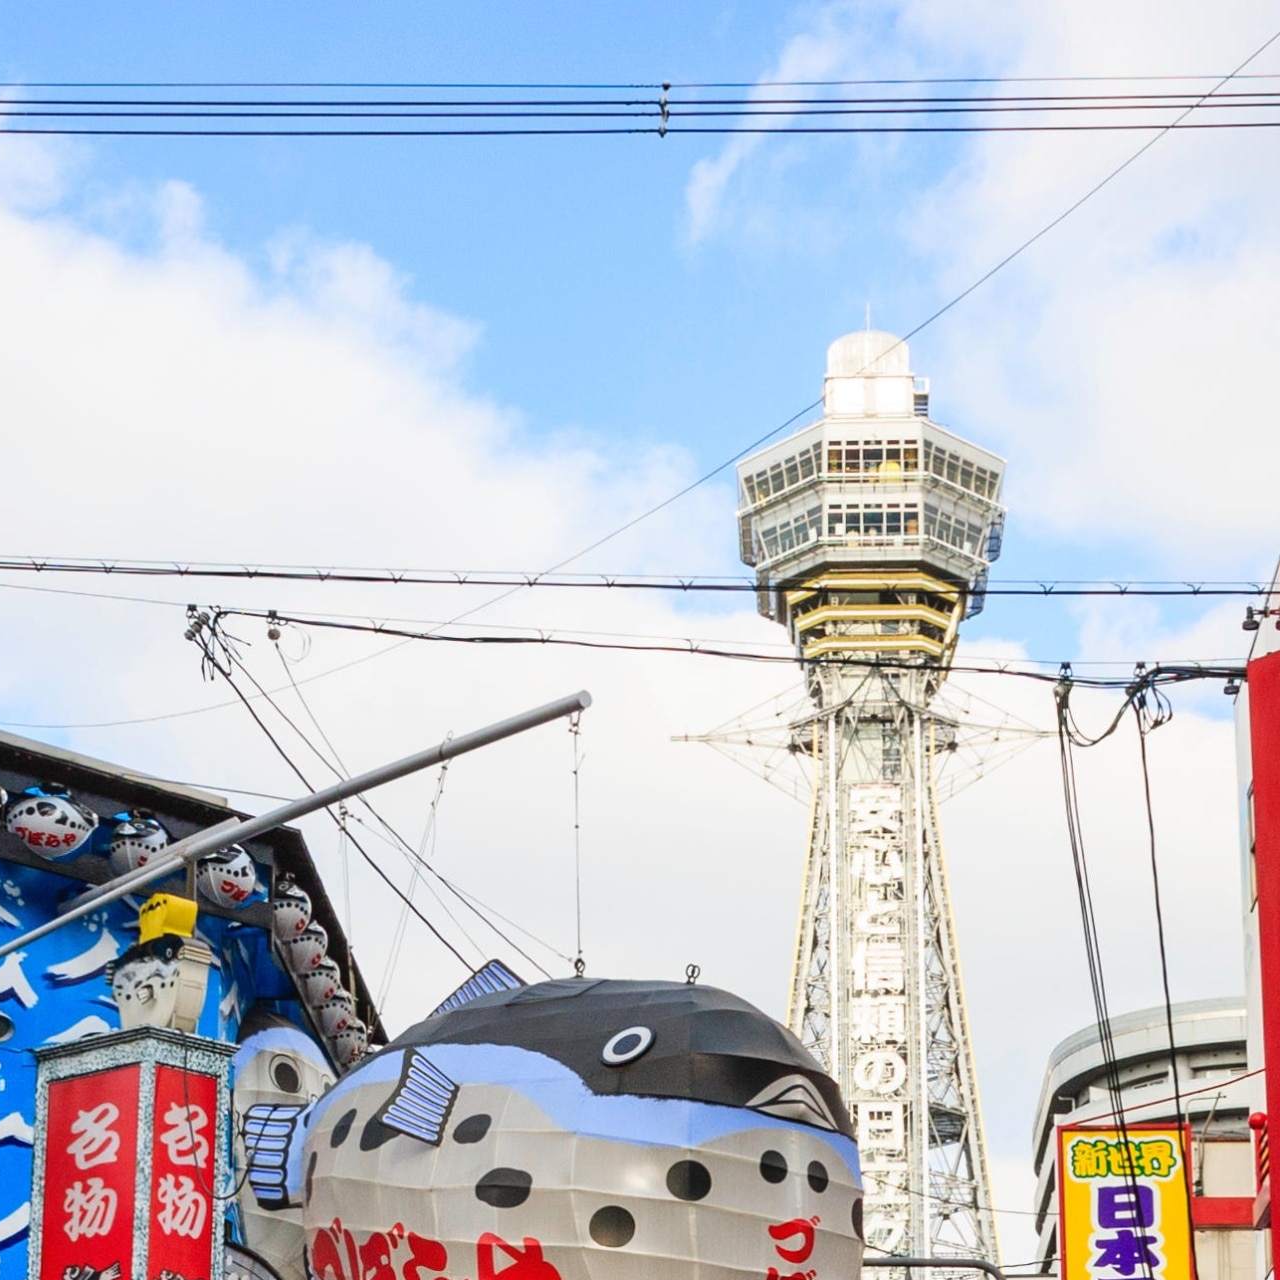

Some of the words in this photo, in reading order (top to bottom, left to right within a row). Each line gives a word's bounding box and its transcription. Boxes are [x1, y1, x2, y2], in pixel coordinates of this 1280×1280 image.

[63, 1101, 121, 1244] 名物
[157, 1101, 210, 1240] 名物
[1070, 1139, 1178, 1179] 新世界
